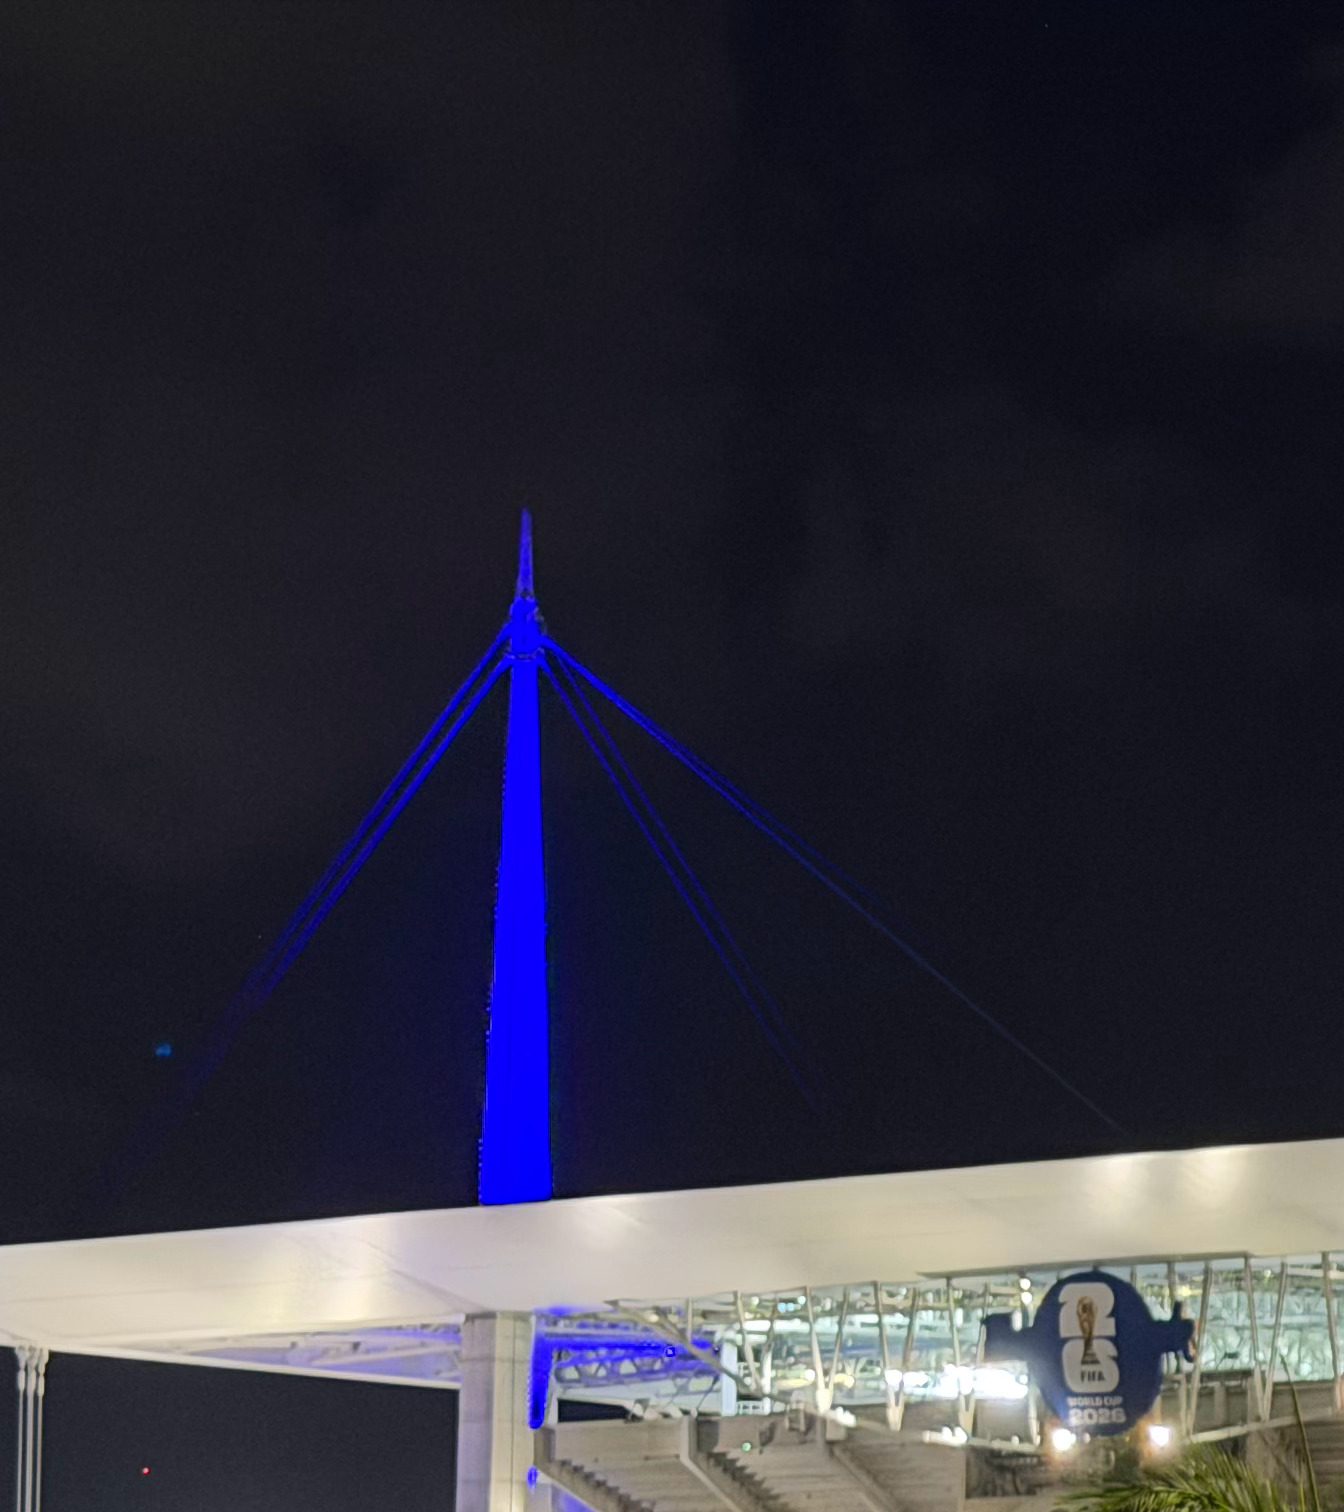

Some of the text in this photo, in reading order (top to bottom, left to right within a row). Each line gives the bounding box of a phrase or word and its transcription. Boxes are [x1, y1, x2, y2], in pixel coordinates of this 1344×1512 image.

[1080, 1370, 1106, 1383] FIFA
[1066, 1395, 1124, 1408] WORLD CUP
[1068, 1408, 1127, 1427] 2026
